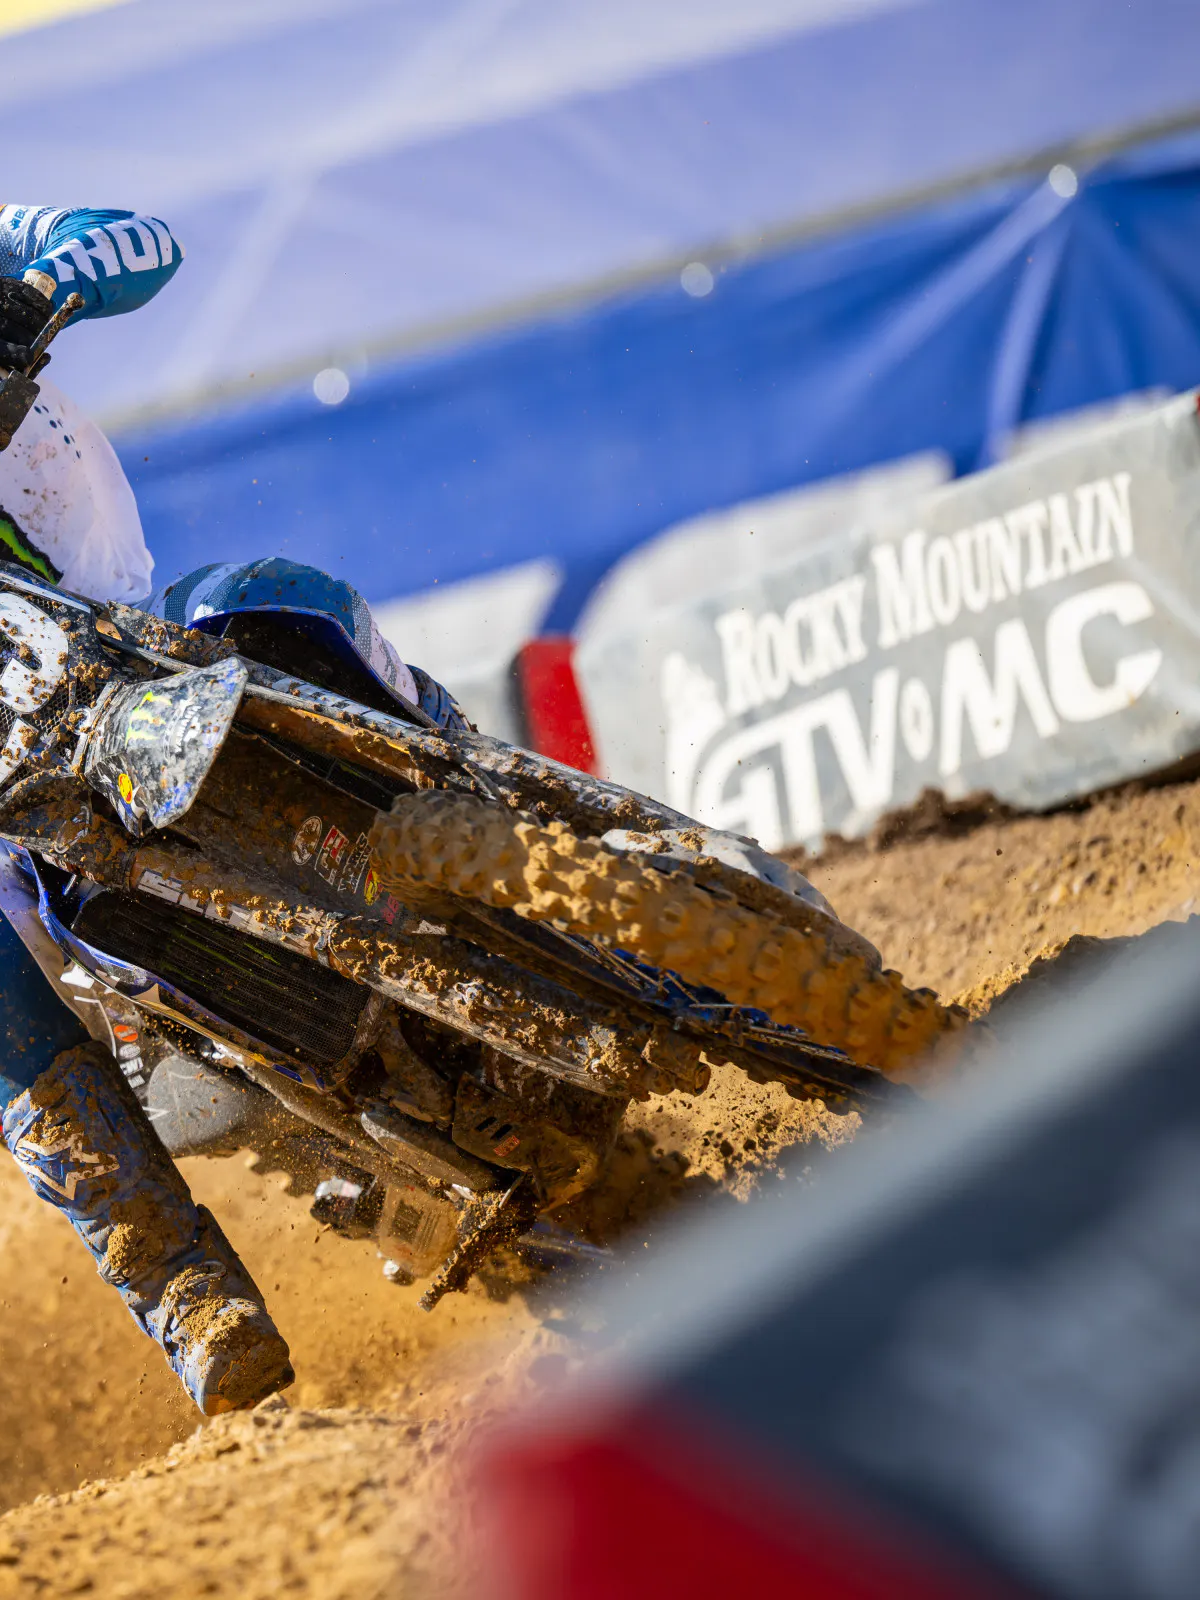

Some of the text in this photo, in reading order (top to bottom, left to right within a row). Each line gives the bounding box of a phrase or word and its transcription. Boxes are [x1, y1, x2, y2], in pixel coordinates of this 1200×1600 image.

[42, 217, 173, 283] THO
[715, 472, 1135, 713] ROCKY MOUNTAIN
